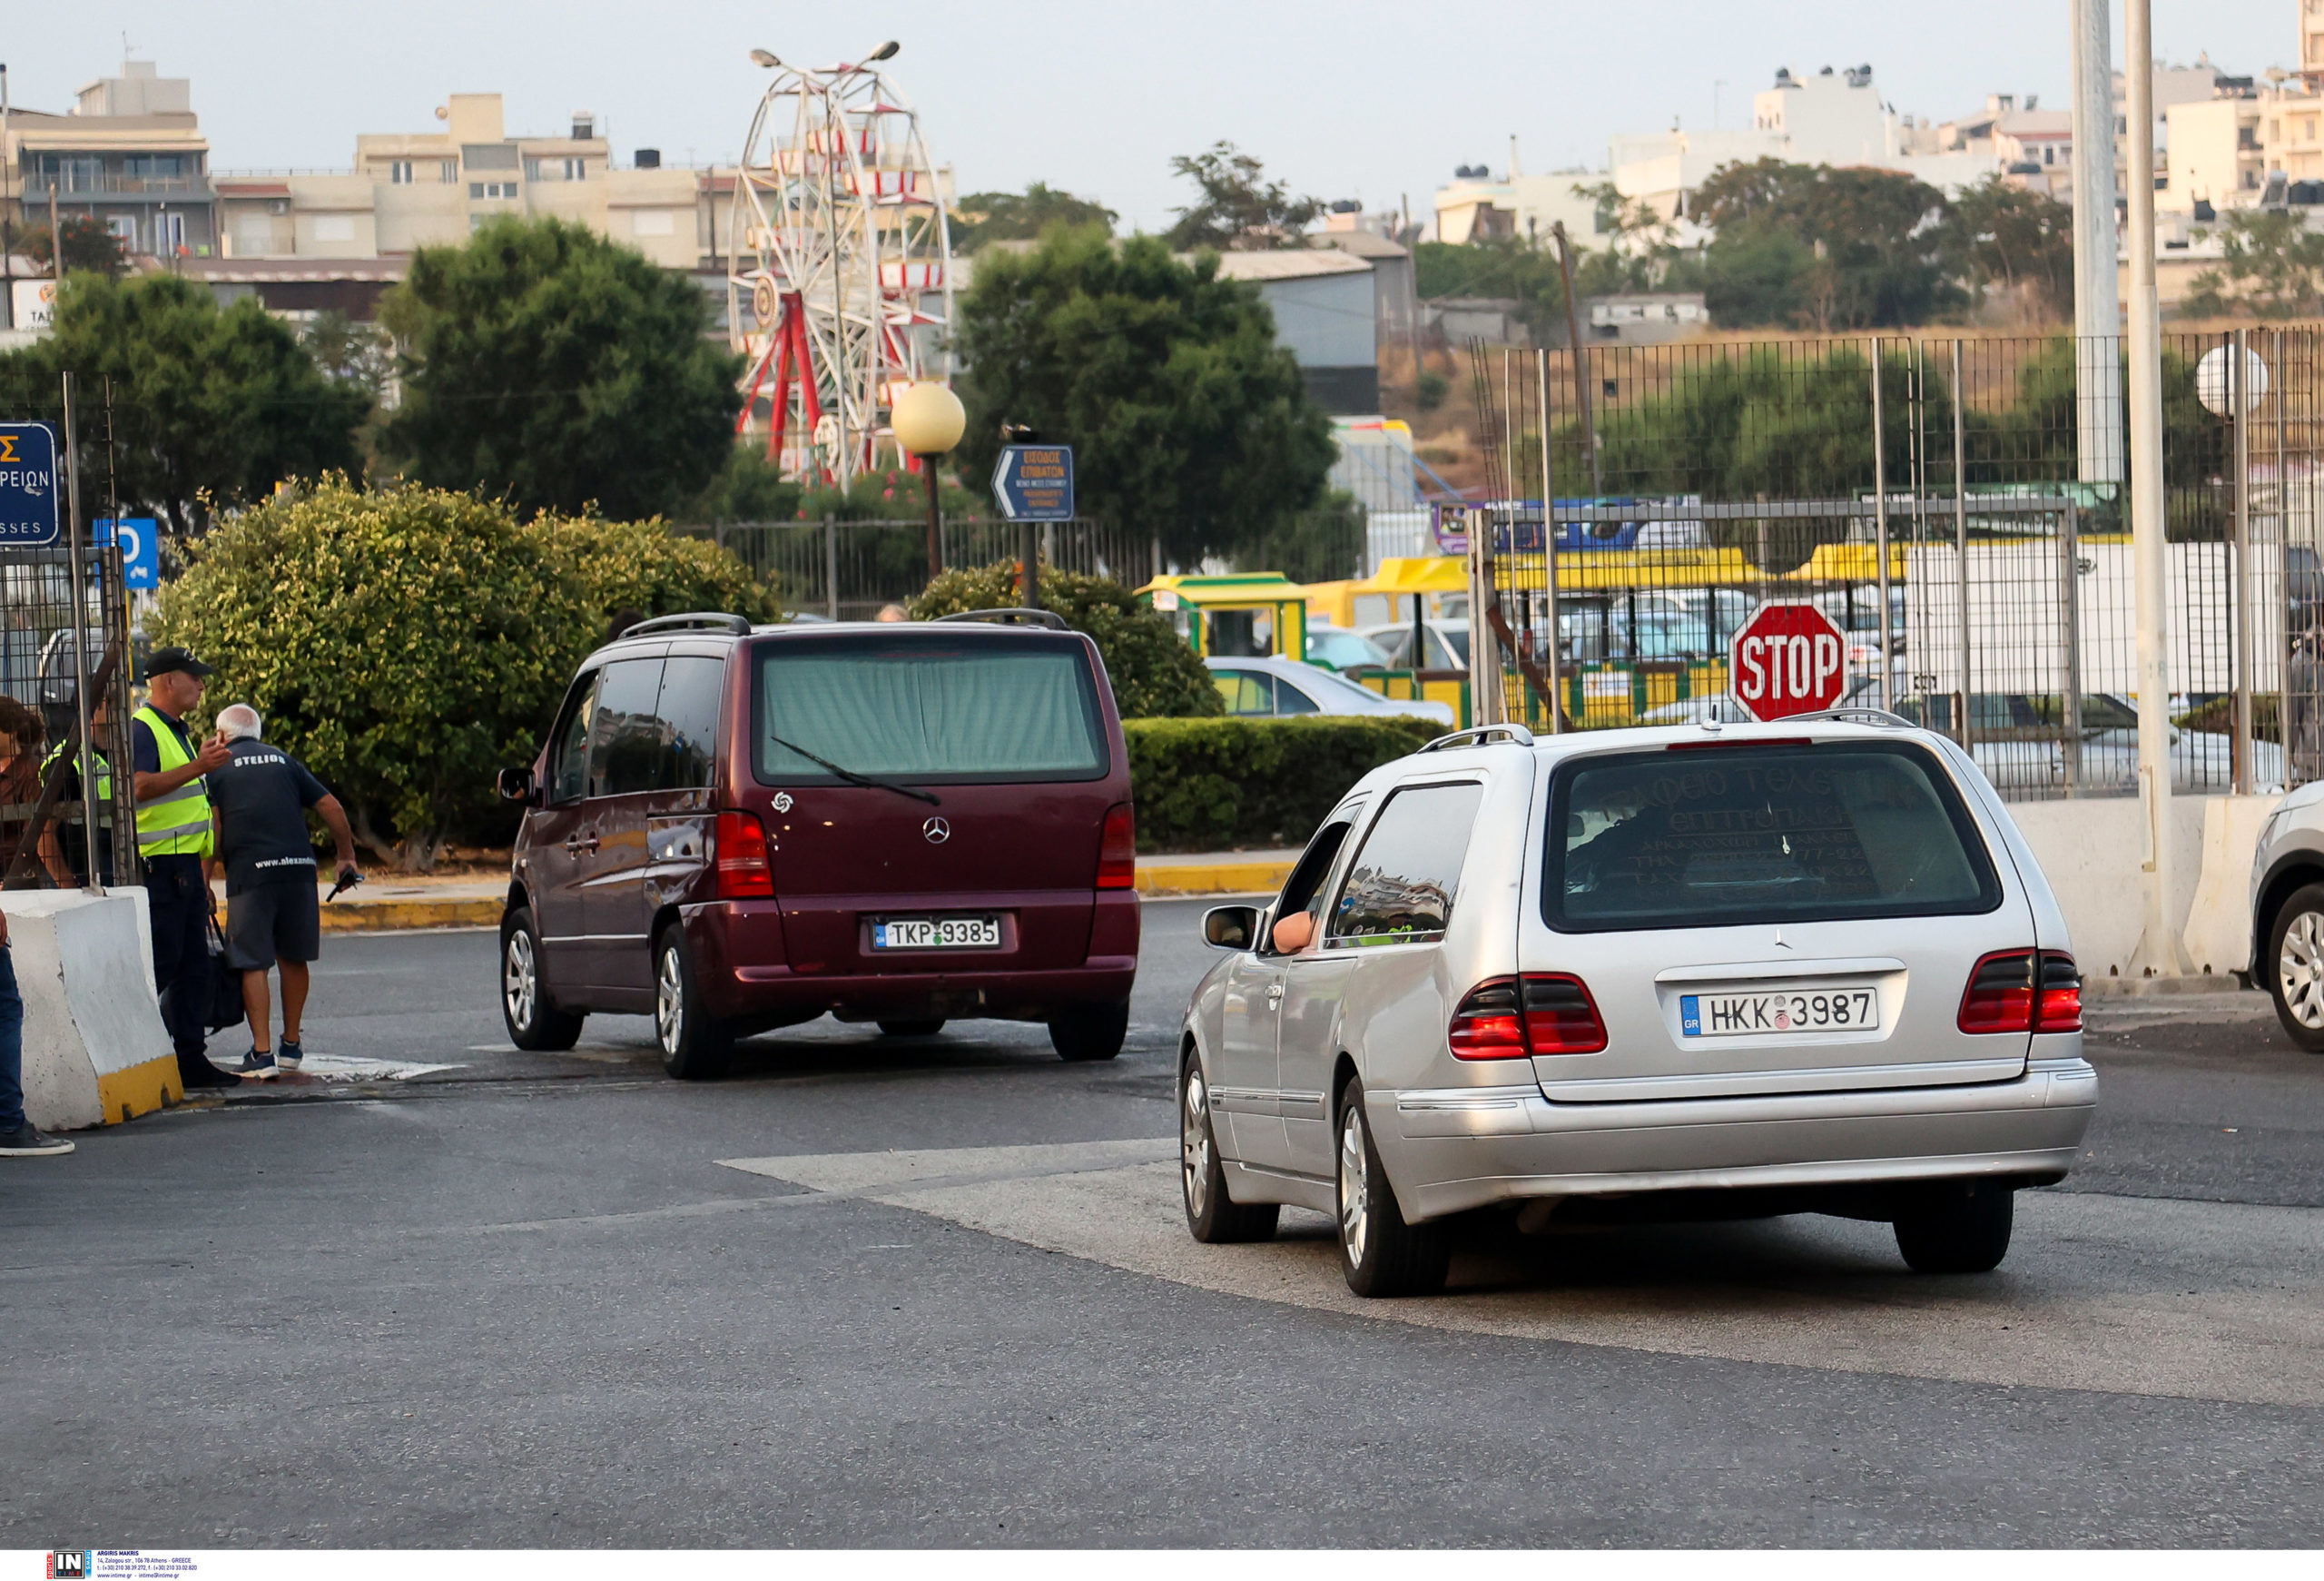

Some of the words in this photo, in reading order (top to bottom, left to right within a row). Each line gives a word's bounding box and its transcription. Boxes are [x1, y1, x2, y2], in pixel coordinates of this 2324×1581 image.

[1023, 450, 1060, 464] ΕΙΣΟΔΟΣ
[1020, 465, 1065, 479] ΕΠΙΒΑΤΩΝ
[1742, 634, 1838, 700] STOP
[233, 754, 286, 767] STELIOS
[1684, 1020, 1699, 1029] GR
